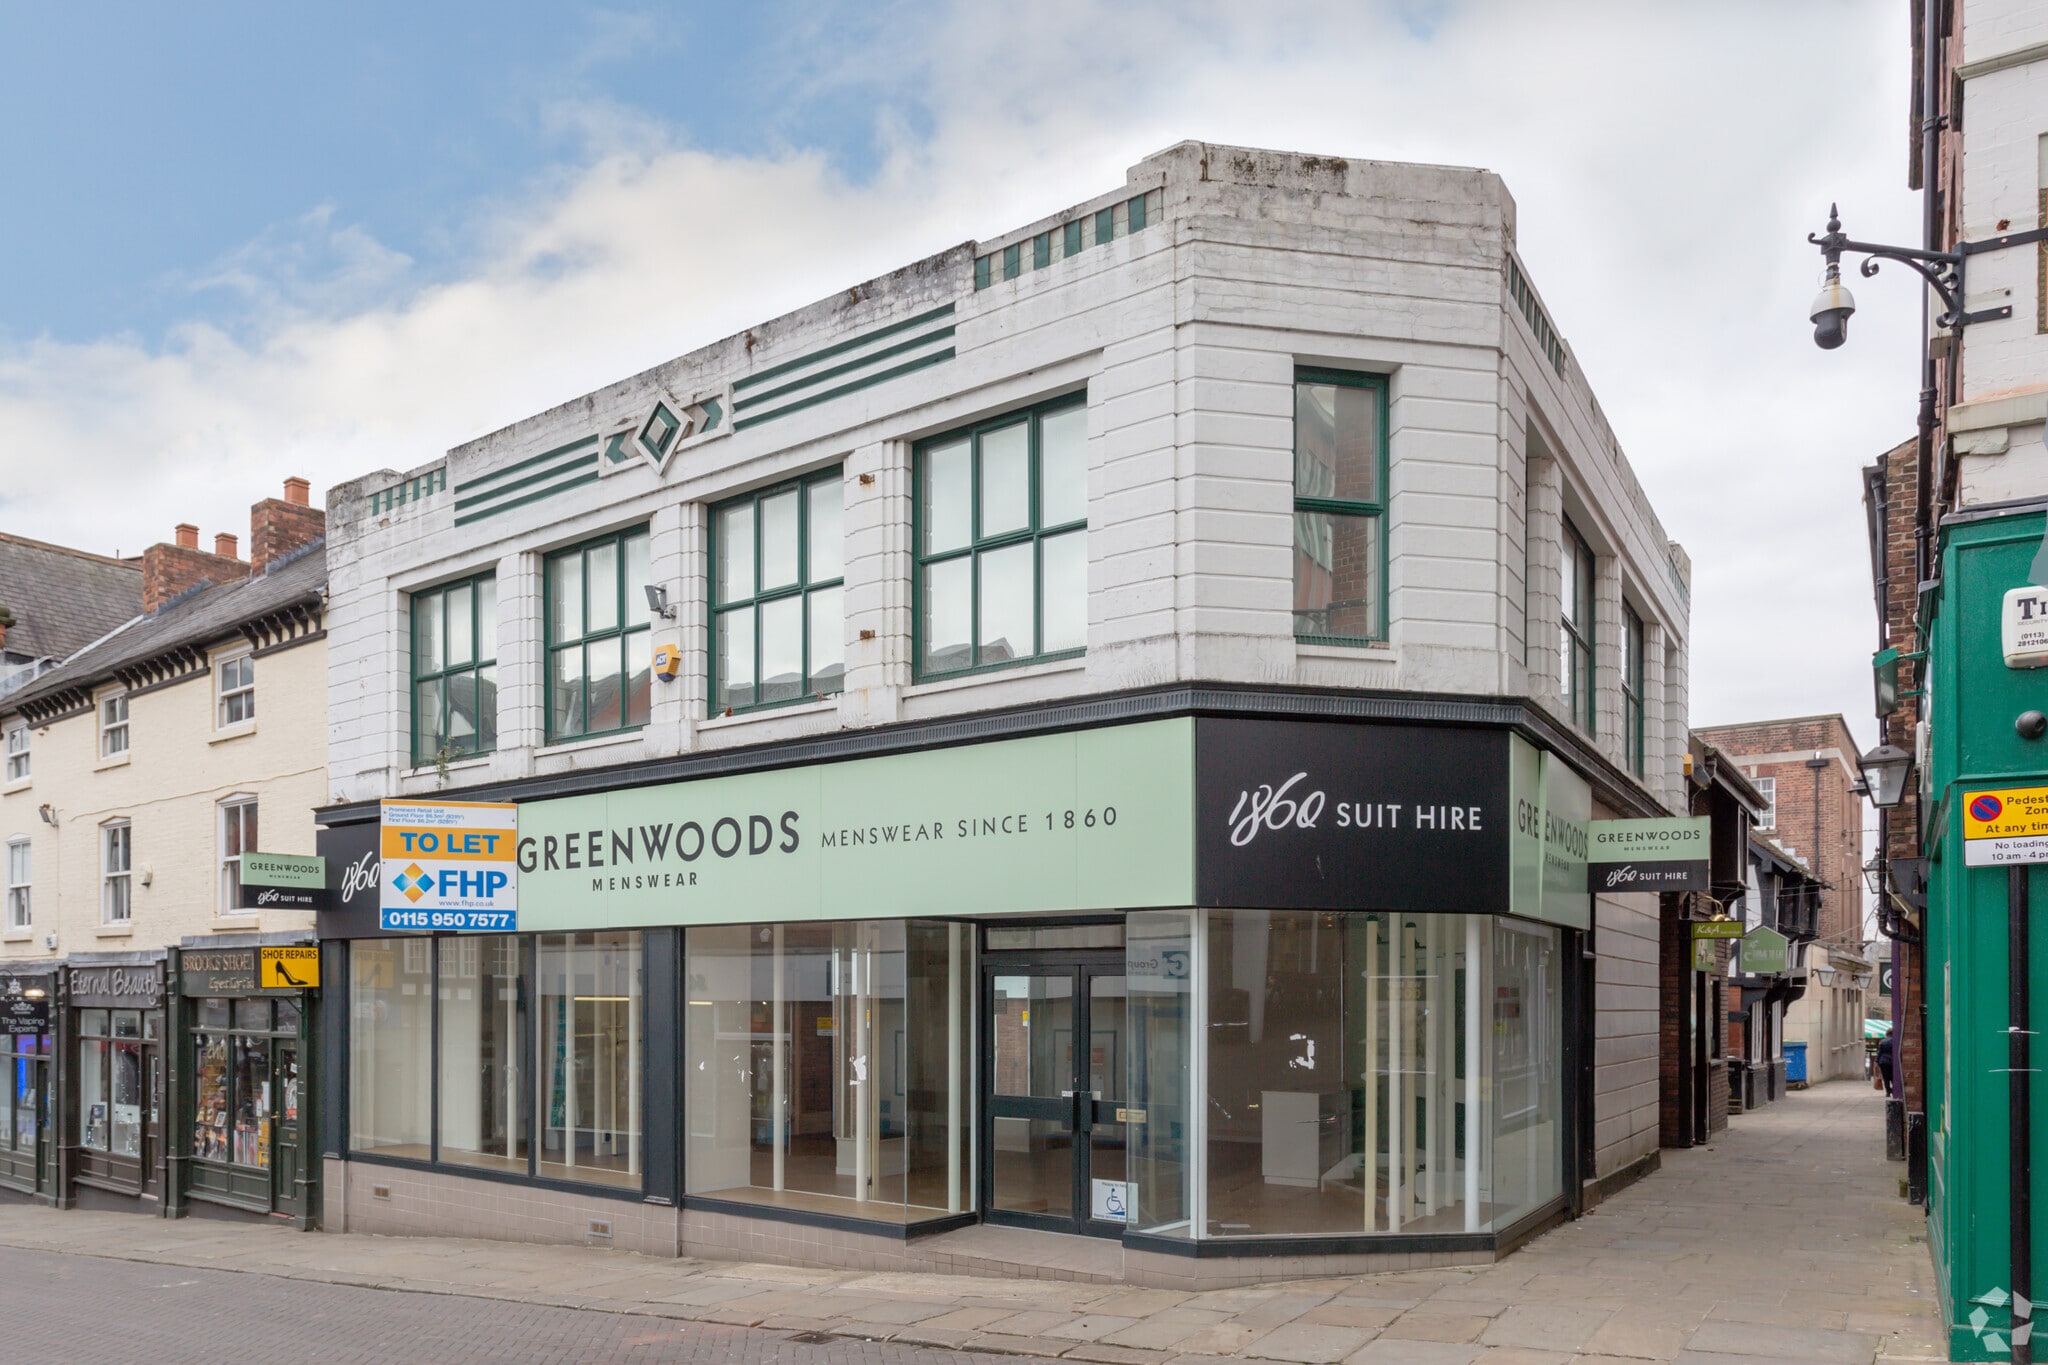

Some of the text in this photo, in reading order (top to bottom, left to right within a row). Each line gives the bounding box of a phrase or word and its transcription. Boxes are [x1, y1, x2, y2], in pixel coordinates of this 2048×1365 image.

[2021, 632, 2045, 640] (0113)
[1228, 772, 1482, 847] 1860 SUIT HIRE
[1518, 799, 1589, 861] GREENWOODS
[1597, 829, 1701, 843] GREENWOODS
[1986, 824, 2000, 833] At
[2004, 824, 2027, 833] any
[400, 832, 500, 854] TO LET
[517, 806, 1117, 873] GREENWOODS MENSWEAR SINCE 1860
[1992, 853, 2003, 861] 10
[250, 862, 320, 874] GREENWOODS
[1606, 865, 1688, 887] 1860 SUIT HIRE
[341, 851, 380, 903] 1860
[438, 870, 508, 898] FHP
[592, 872, 698, 892] MENSWEAR
[257, 889, 279, 905] 1860
[280, 895, 295, 903] SUIT
[439, 900, 494, 908] www.fhp.co.uk
[390, 912, 509, 927] 0115 950 7577
[183, 954, 221, 972] BROOKS
[262, 950, 317, 960] SHOE REPAIRS
[70, 968, 158, 1006] Eternal Beauty
[1, 1016, 45, 1026] The Vaping
[9, 1025, 38, 1033] Experts
